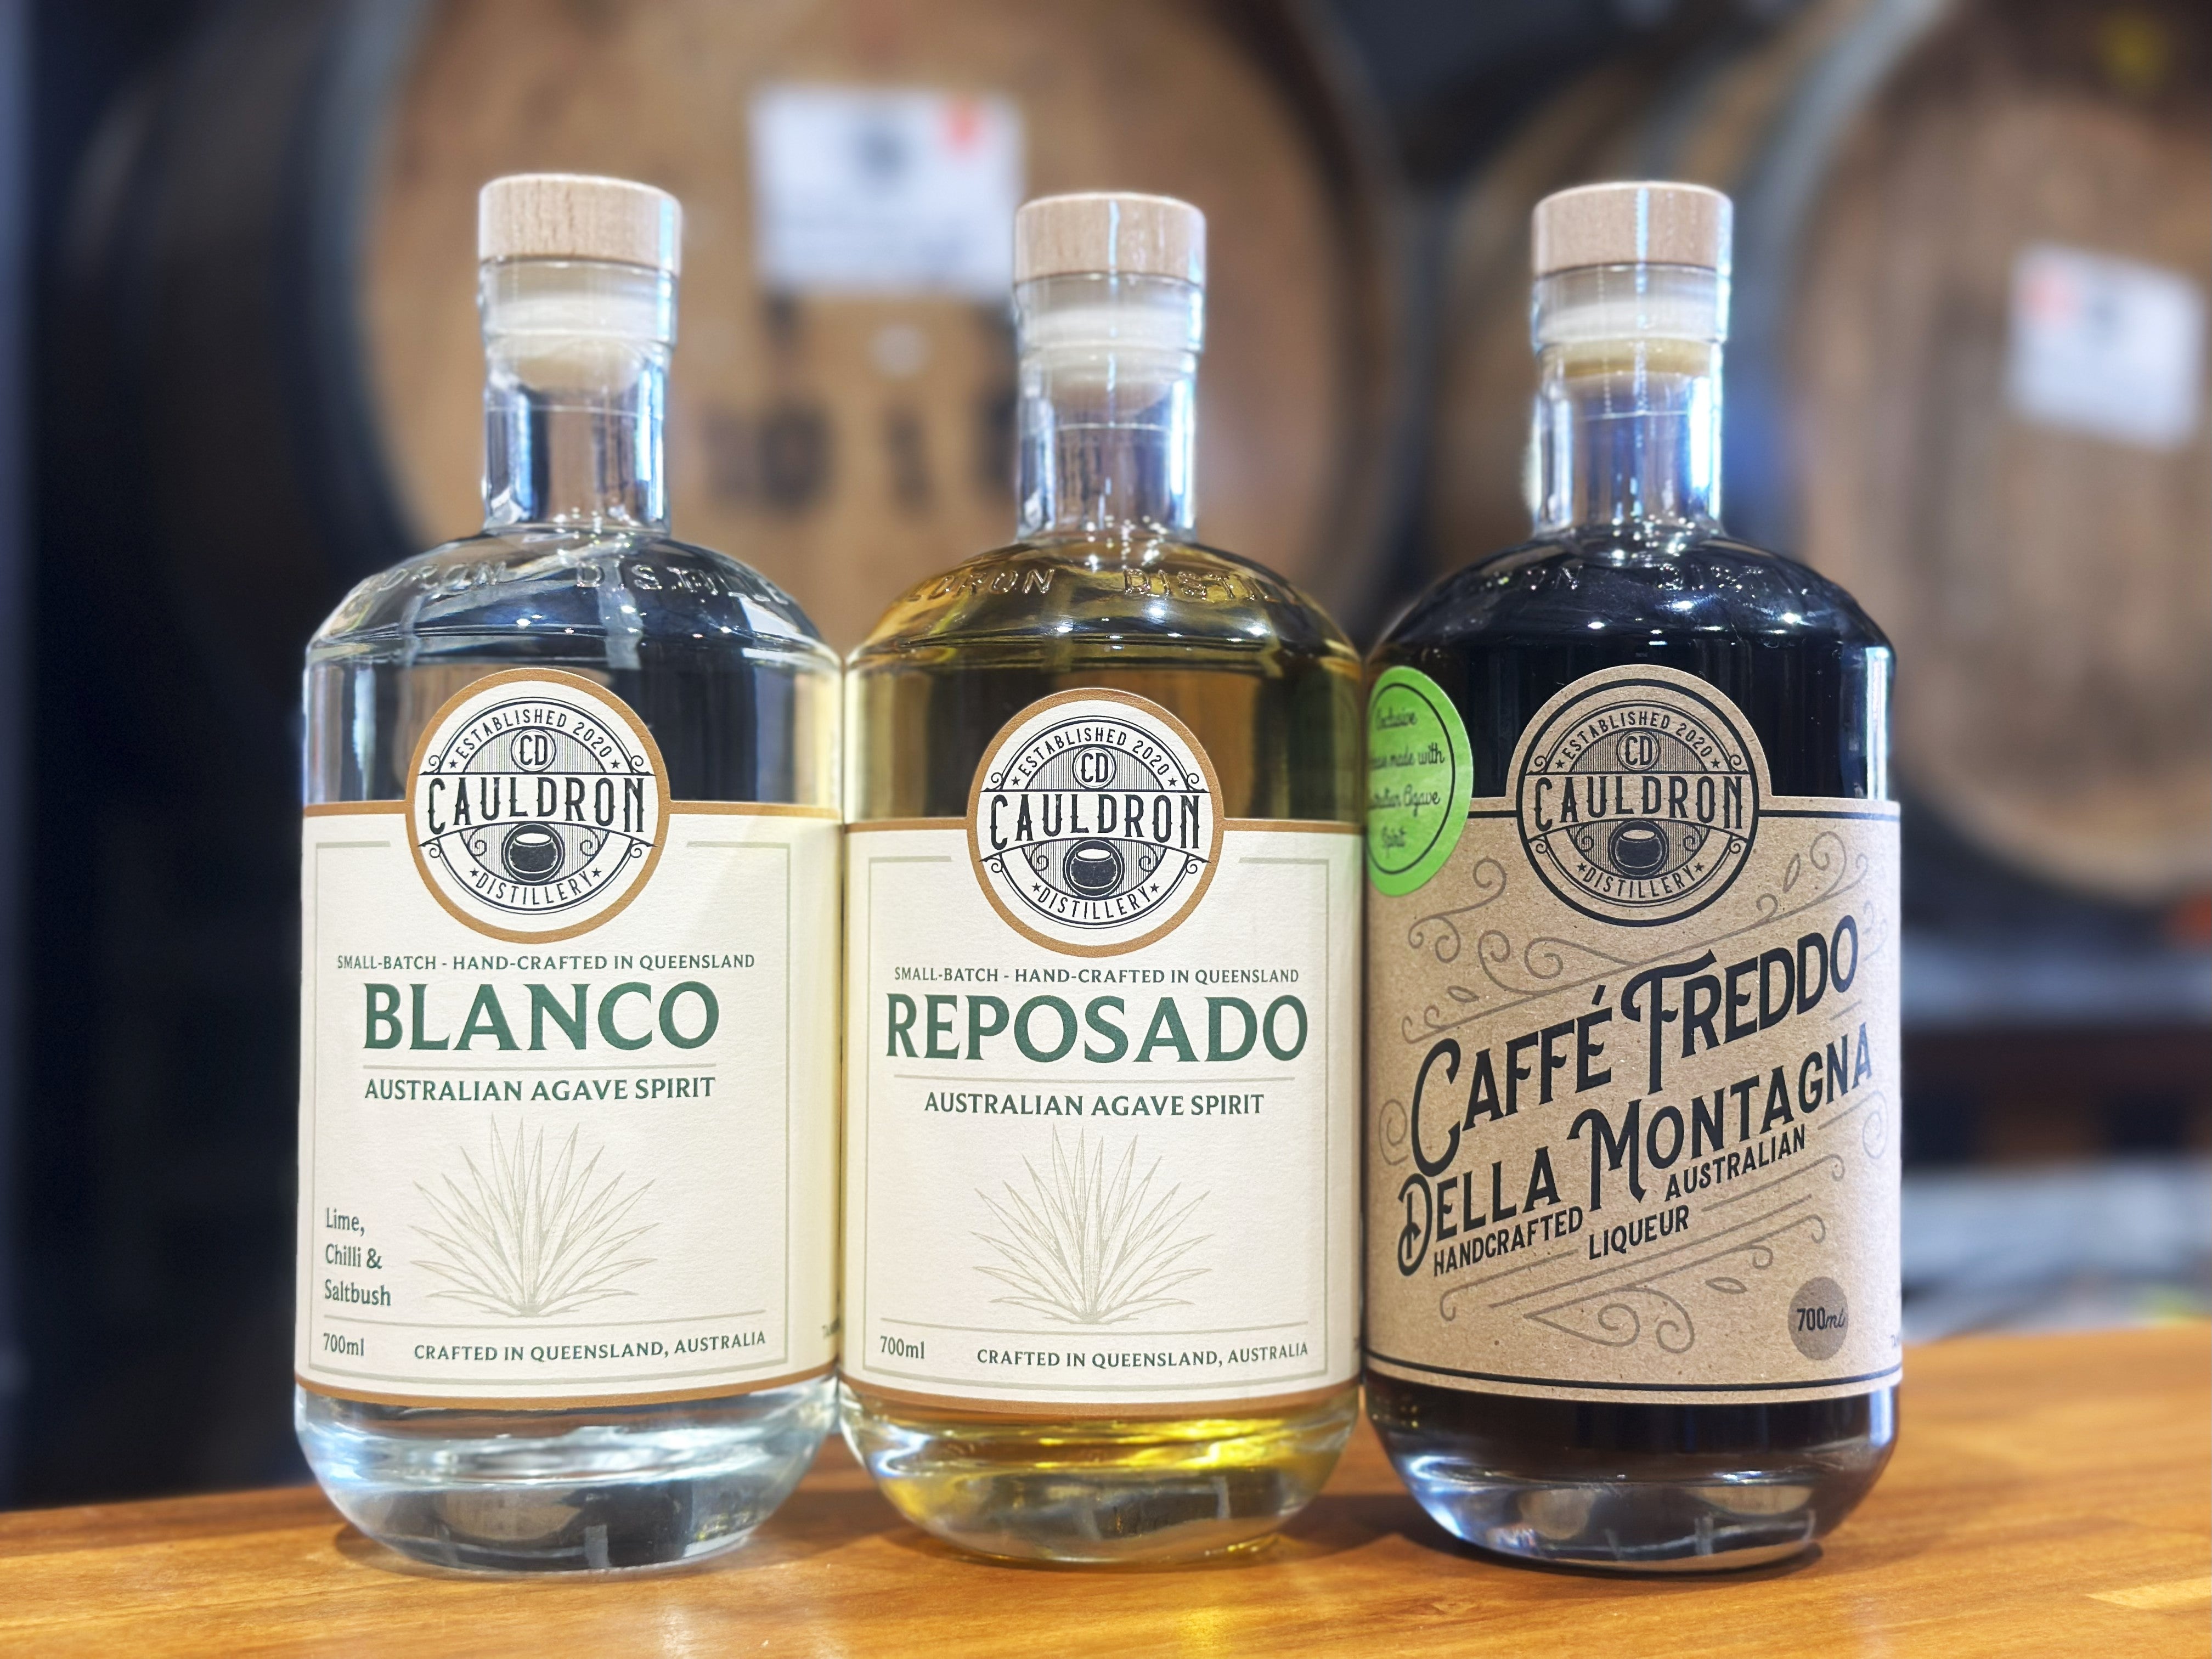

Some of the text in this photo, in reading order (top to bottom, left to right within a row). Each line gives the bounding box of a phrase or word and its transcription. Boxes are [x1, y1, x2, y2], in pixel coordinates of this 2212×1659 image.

[456, 708, 612, 759] ESTABLISHED 2020
[1562, 711, 1713, 759] ESTABLISHED 2020
[519, 735, 549, 766] CD
[1019, 727, 1170, 776] ESTABLISHED 2020
[1418, 742, 1445, 765] with
[1625, 736, 1652, 766] CD
[1081, 753, 1108, 783] CD
[427, 776, 645, 833] CAULDRON
[1533, 776, 1742, 832] CAULDRON
[990, 794, 1199, 850] CAULDRON
[476, 872, 595, 905] DISTILLERY
[1583, 866, 1696, 898] DISTILLERY
[1039, 887, 1153, 919] DISTILLERY
[337, 955, 436, 970] SMALL-BATCH
[453, 955, 608, 970] HAND-CRAFTED
[613, 955, 633, 970] IN
[639, 953, 755, 972] QUEENSLAND
[895, 966, 999, 983] SMALL-BATCH
[1014, 968, 1165, 984] HAND-CRAFTED
[1170, 969, 1189, 984] IN
[1195, 969, 1299, 985] QUEENSLAND
[363, 981, 720, 1051] BLANCO
[886, 993, 1308, 1064] REPOSADO
[1411, 915, 1858, 1177] CAFFÉ FREDDO
[364, 1076, 716, 1102] AUSTRALIAN AGAVE SPIRIT
[924, 1092, 1264, 1117] AUSTRALIAN AGAVE SPIRIT
[1397, 1022, 1872, 1277] DELLA MONTAGNA
[1433, 1126, 1805, 1277] HANDCRAFTED AUSTRALIAN
[325, 1206, 365, 1237] Lime,
[1588, 1205, 1690, 1260] LIQUEUR
[325, 1243, 383, 1270] Chilli &
[324, 1278, 391, 1307] Saltbush
[323, 1333, 365, 1357] 700ml
[414, 1330, 766, 1363] CRAFTED IN QUEENSLAND, AUSTRALIA
[880, 1335, 925, 1360] 700ml
[977, 1341, 1308, 1370] CRAFTED IN QUEENSLAND, AUSTRALIA
